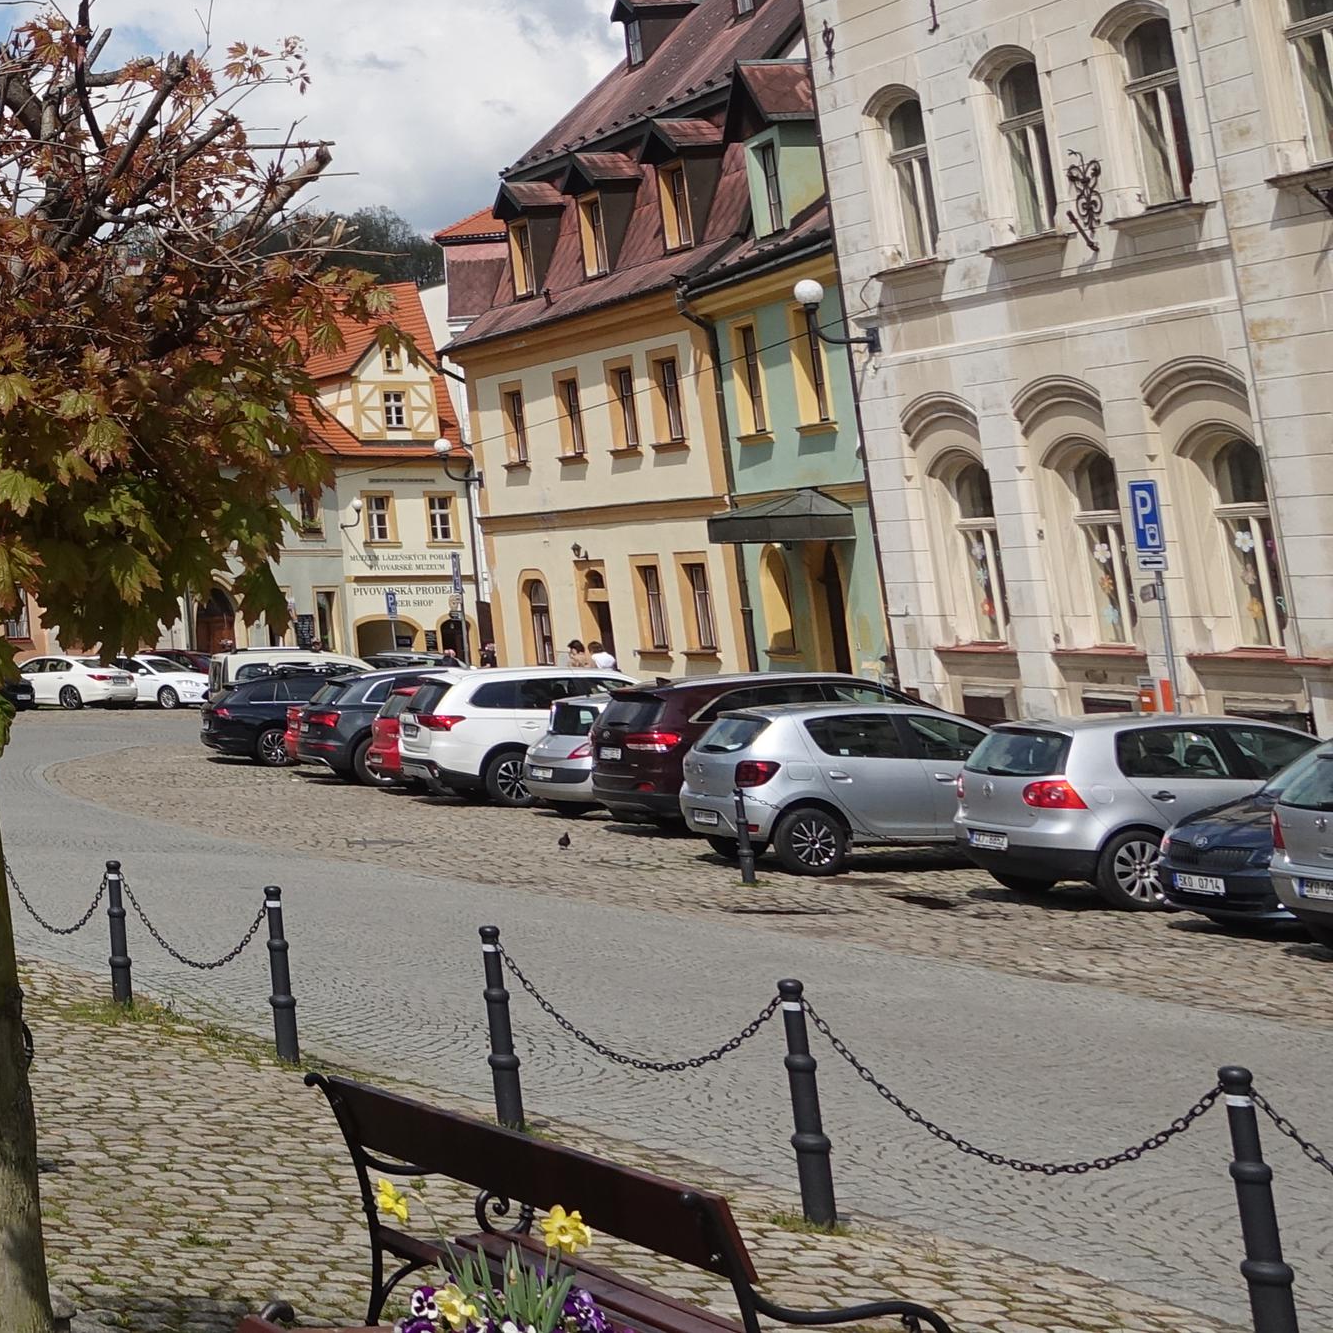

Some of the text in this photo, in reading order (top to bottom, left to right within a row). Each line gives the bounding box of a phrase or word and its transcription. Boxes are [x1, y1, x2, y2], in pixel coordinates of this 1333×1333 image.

[1134, 490, 1152, 529] P
[349, 554, 379, 562] MUZEUM
[415, 563, 446, 571] MUZEUM
[353, 584, 412, 596] PIVOVARSKÁ
[412, 599, 434, 607] SHOP
[1198, 878, 1220, 891] 0714
